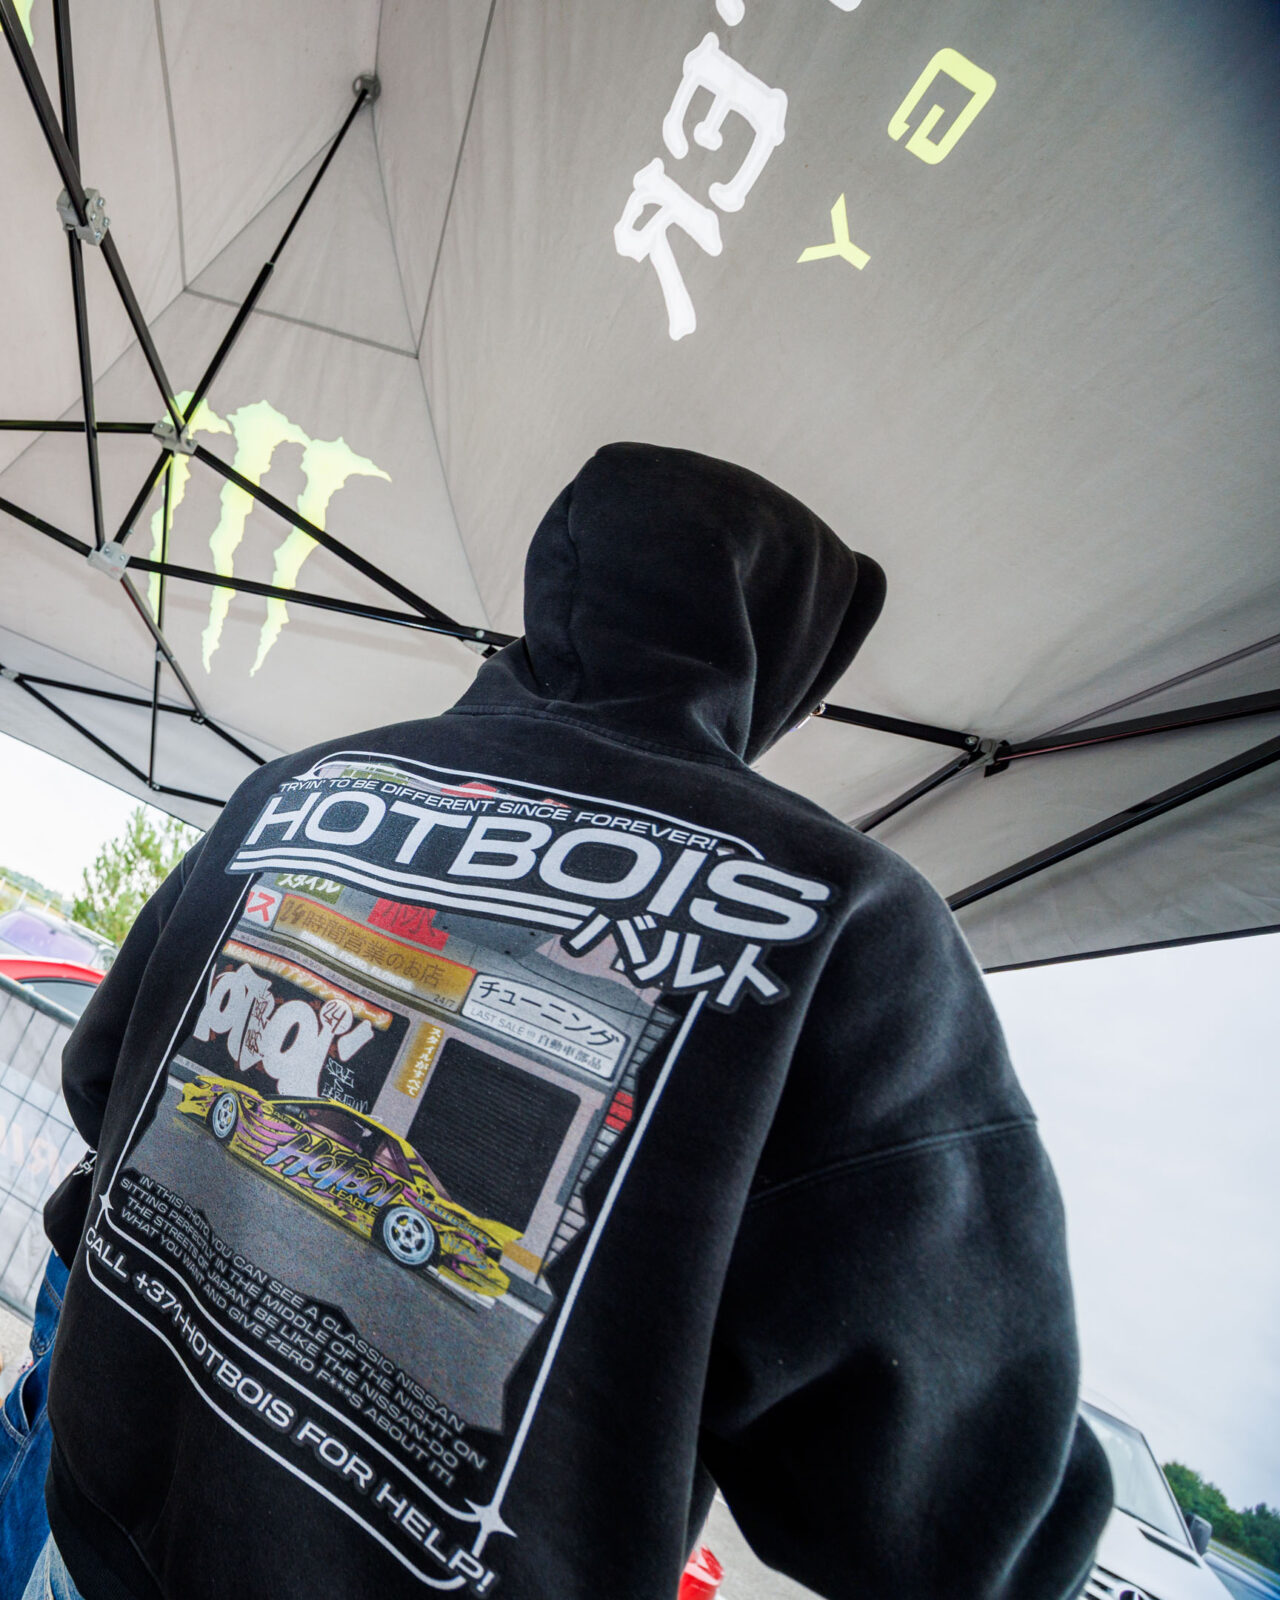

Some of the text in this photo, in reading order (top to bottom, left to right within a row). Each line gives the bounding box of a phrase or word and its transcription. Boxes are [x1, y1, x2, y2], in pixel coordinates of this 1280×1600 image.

[246, 790, 830, 944] HOTBOIS
[280, 778, 719, 850] TRYIN' TO BE DIFFERENT SINCE FOREVER!
[470, 1007, 496, 1023] LAST
[499, 1015, 527, 1036] SALE
[479, 981, 620, 1046] チューニング
[563, 910, 782, 1008] バルト
[120, 1178, 488, 1470] SITTING PERFECTLY IN THE MIDDLE OF THE NIGHT ON
[121, 1207, 159, 1238] WHAT
[160, 1235, 183, 1258] YOU
[182, 1256, 205, 1285] WANT
[203, 1283, 228, 1310] AND
[228, 1306, 266, 1339] GIVE
[266, 1334, 315, 1373] ZERO
[364, 1407, 429, 1460] ABOUT
[428, 1460, 456, 1487] IT!
[127, 1197, 154, 1219] THE
[153, 1215, 198, 1257] STREETS
[197, 1255, 210, 1270] OF
[253, 1307, 281, 1330] BE
[280, 1324, 320, 1358] LIKE
[322, 1352, 360, 1385] THE
[360, 1382, 459, 1469] NISSAN-DO
[140, 1175, 154, 1189] IN
[157, 1184, 184, 1209] THIS
[211, 1232, 233, 1259] YOU
[233, 1255, 268, 1284] CAN
[269, 1280, 304, 1309] SEE
[305, 1306, 318, 1320] A
[322, 1316, 395, 1375] CLASSIC
[396, 1372, 465, 1433] NISSAN
[84, 1226, 127, 1279] CALL
[296, 1419, 375, 1489] FOR
[376, 1482, 497, 1594] HELP!
